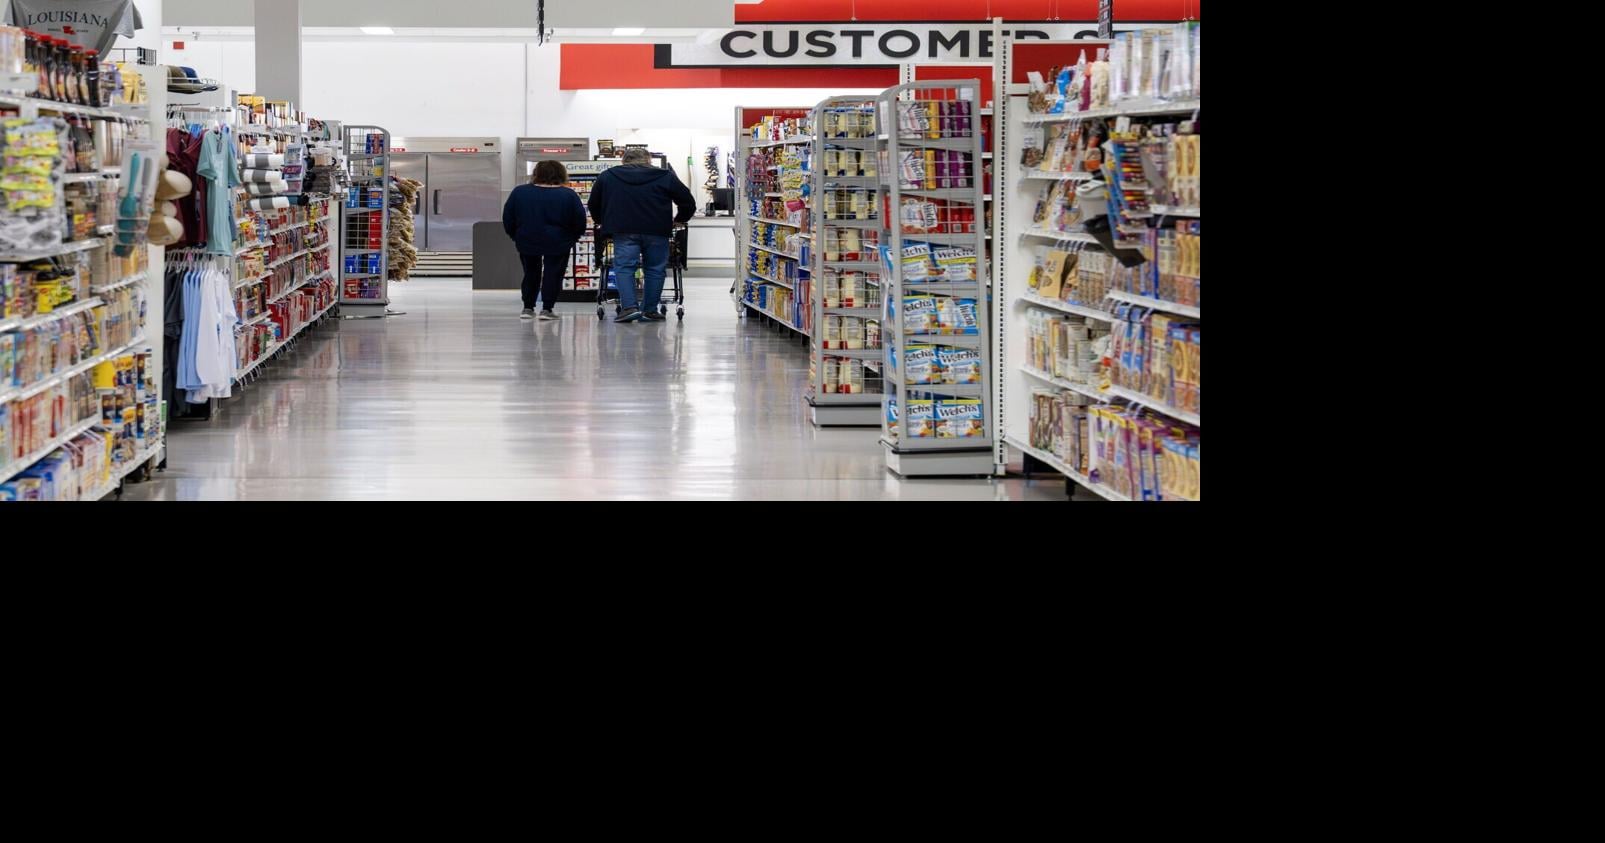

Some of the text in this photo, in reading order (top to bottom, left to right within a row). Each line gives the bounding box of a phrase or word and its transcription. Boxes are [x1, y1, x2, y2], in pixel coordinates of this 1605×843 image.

[28, 10, 109, 29] LOUISIANA
[565, 162, 593, 172] Great
[939, 403, 978, 417] Welch's
